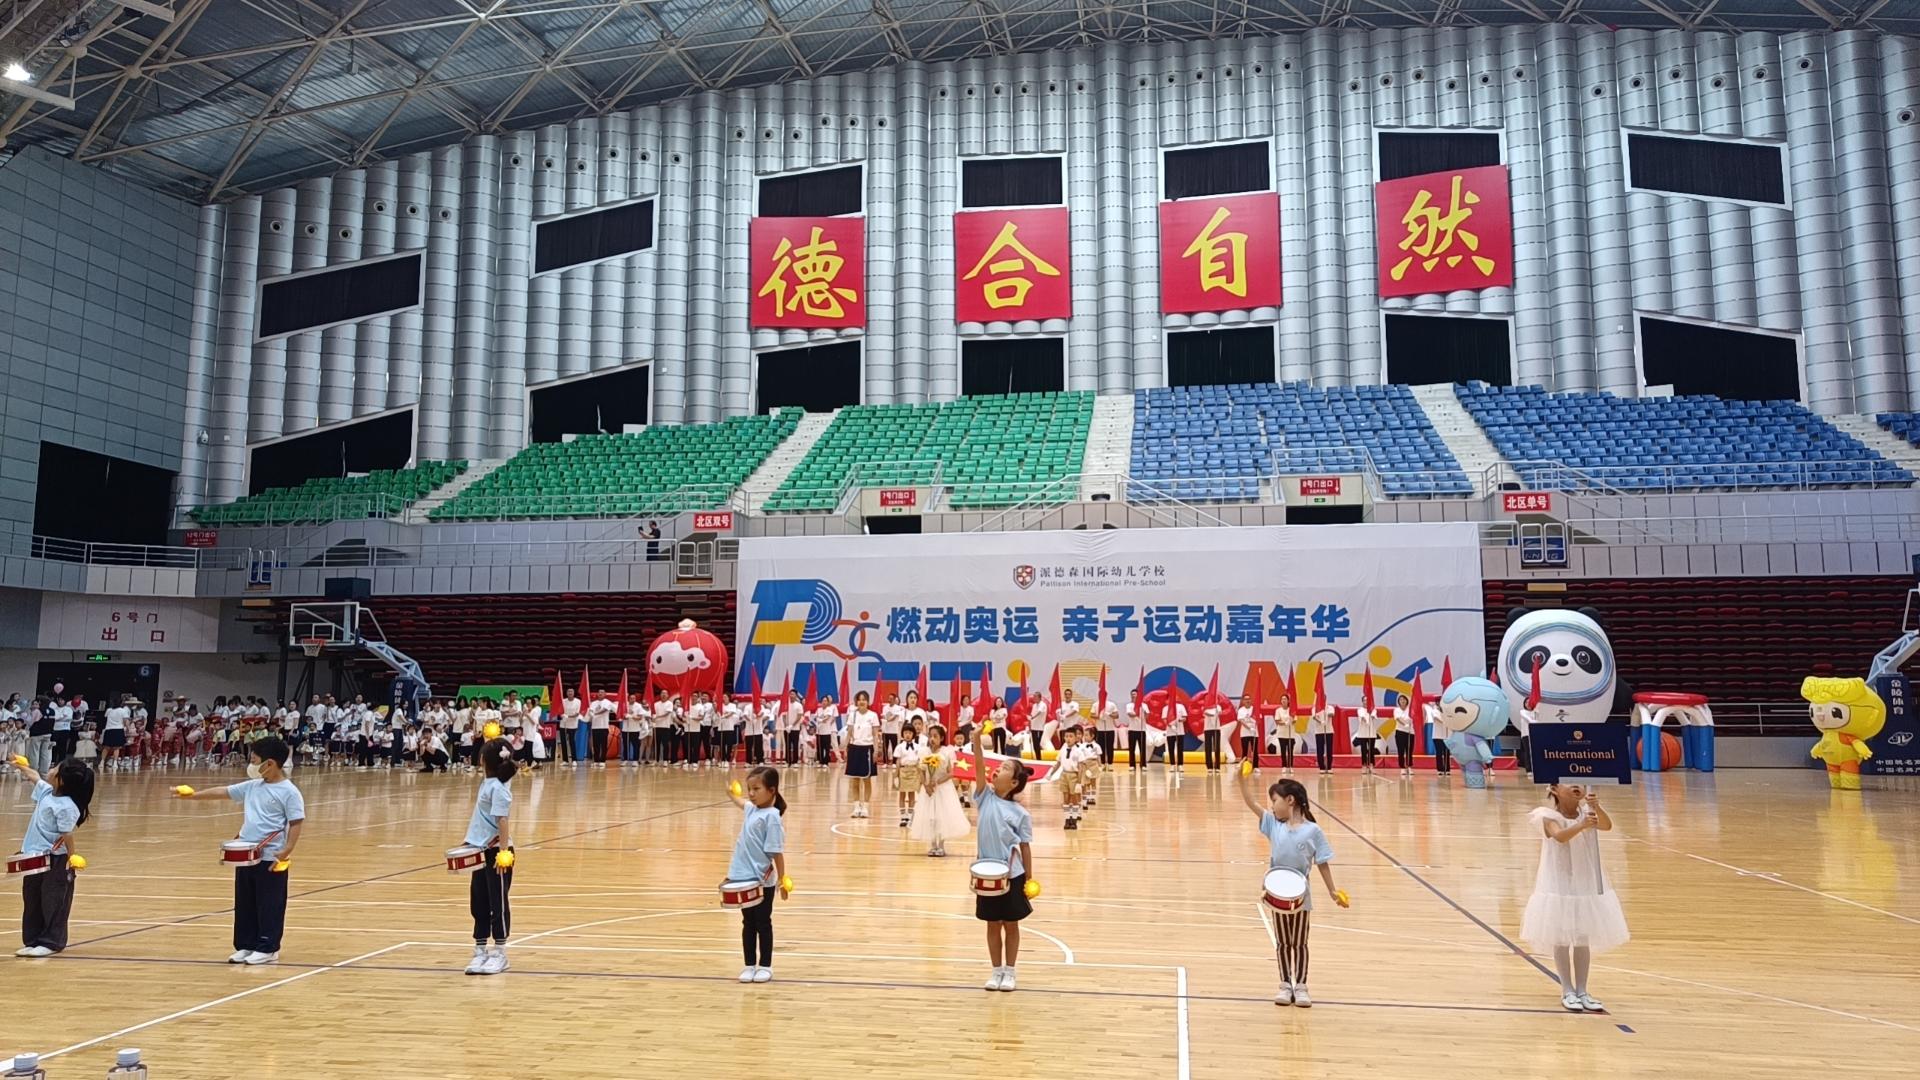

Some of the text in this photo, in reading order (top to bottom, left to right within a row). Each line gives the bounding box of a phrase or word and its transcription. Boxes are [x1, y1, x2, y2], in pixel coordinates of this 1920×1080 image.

[1389, 174, 1496, 280] 然
[1182, 207, 1249, 298] 自
[962, 221, 1061, 308] 合
[758, 226, 858, 318] 德
[1507, 495, 1547, 509] 北区单号
[696, 515, 730, 528] 北区双号
[1040, 565, 1166, 578] 派德森国际幼儿学校
[1073, 579, 1122, 588] International
[1124, 579, 1166, 587] Pre-School
[886, 604, 1350, 645] 燃动奥运 亲子运动嘉年华
[141, 666, 150, 677] 6
[1544, 749, 1615, 759] International
[1569, 763, 1592, 773] One
